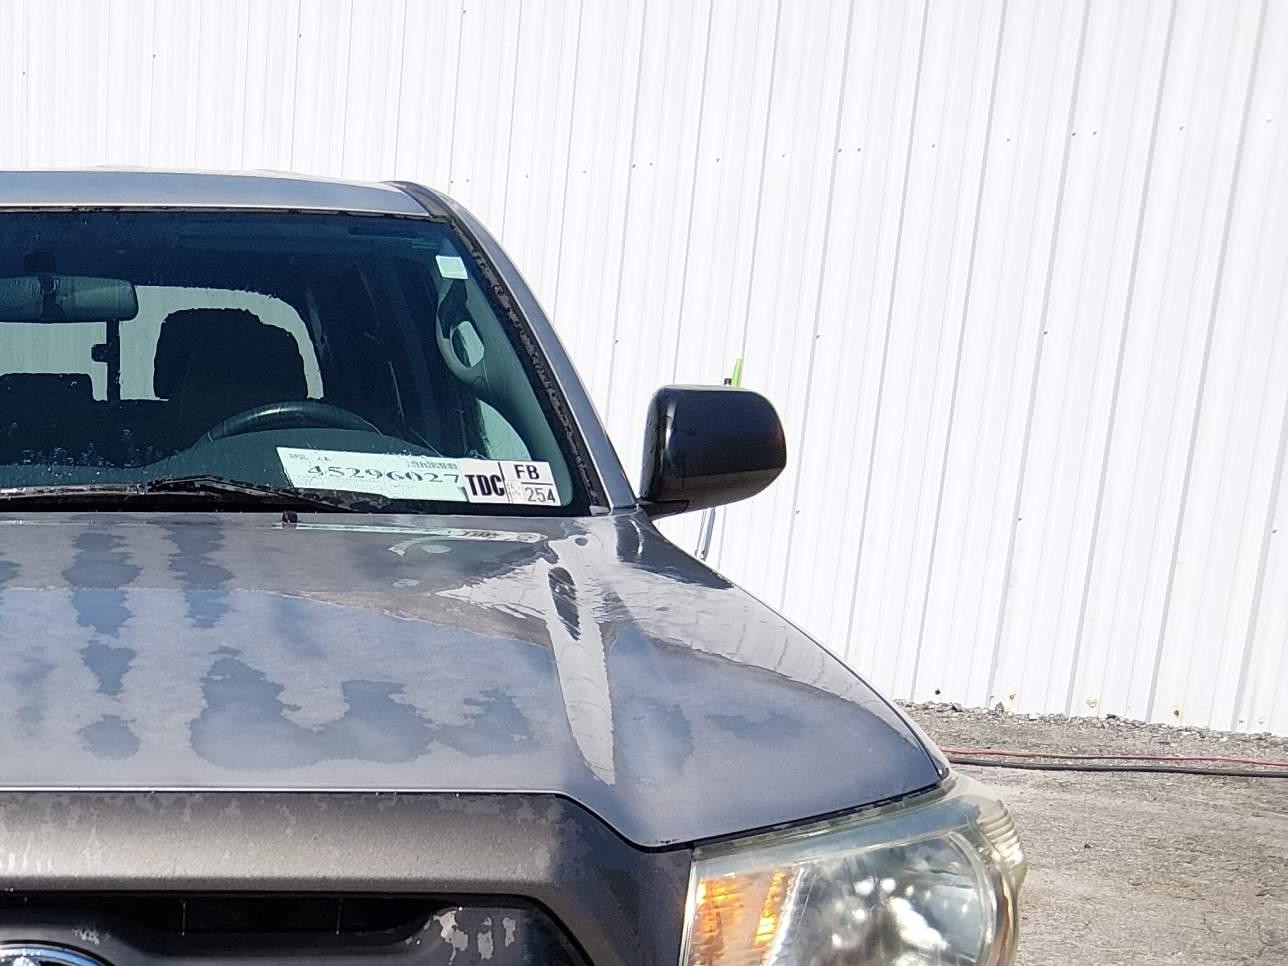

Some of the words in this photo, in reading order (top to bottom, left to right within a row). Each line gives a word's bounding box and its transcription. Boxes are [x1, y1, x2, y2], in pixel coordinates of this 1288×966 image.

[307, 465, 460, 484] 45296027
[514, 464, 540, 480] FB
[464, 474, 505, 497] TDC
[525, 487, 556, 503] 254
